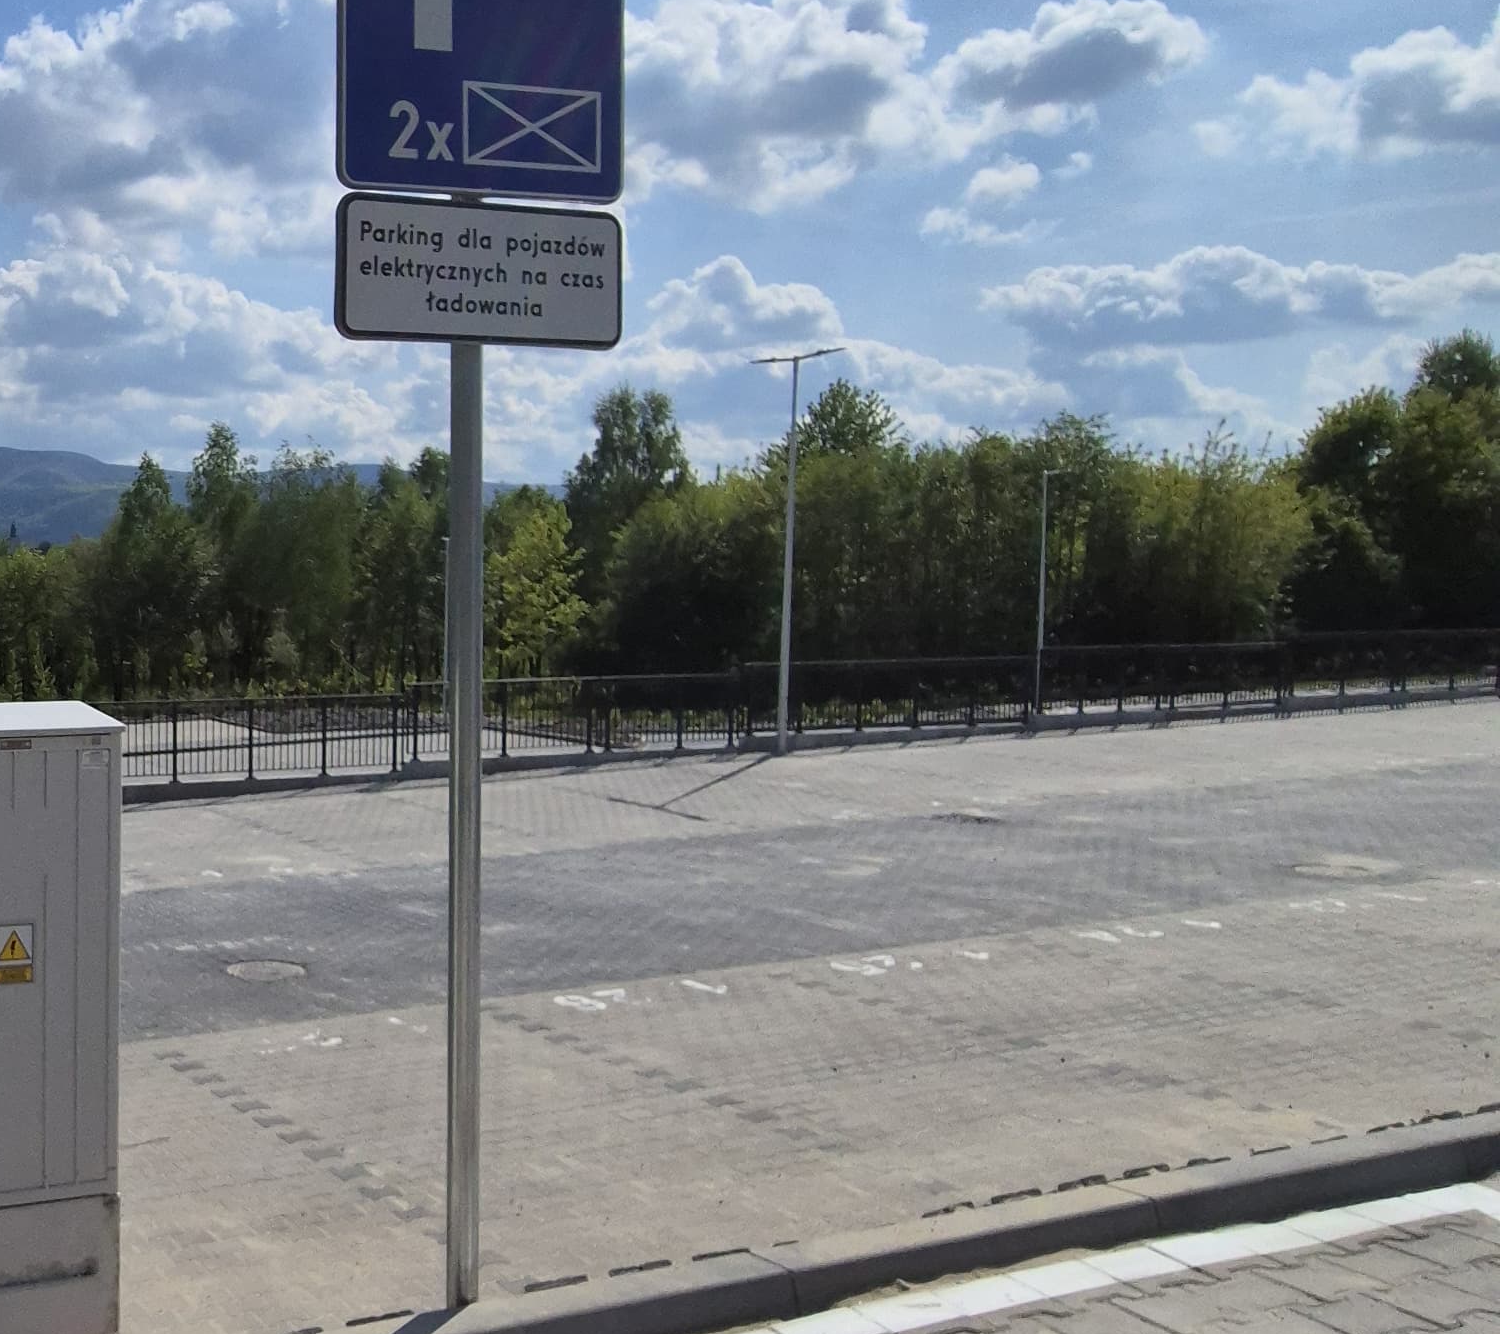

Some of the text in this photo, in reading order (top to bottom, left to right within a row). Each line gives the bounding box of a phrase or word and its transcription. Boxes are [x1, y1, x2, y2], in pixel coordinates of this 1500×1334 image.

[387, 99, 455, 162] 2x
[359, 220, 605, 258] Parking dla pojazdów
[358, 255, 605, 290] elektrycznych na czas
[425, 290, 544, 317] ładowania
